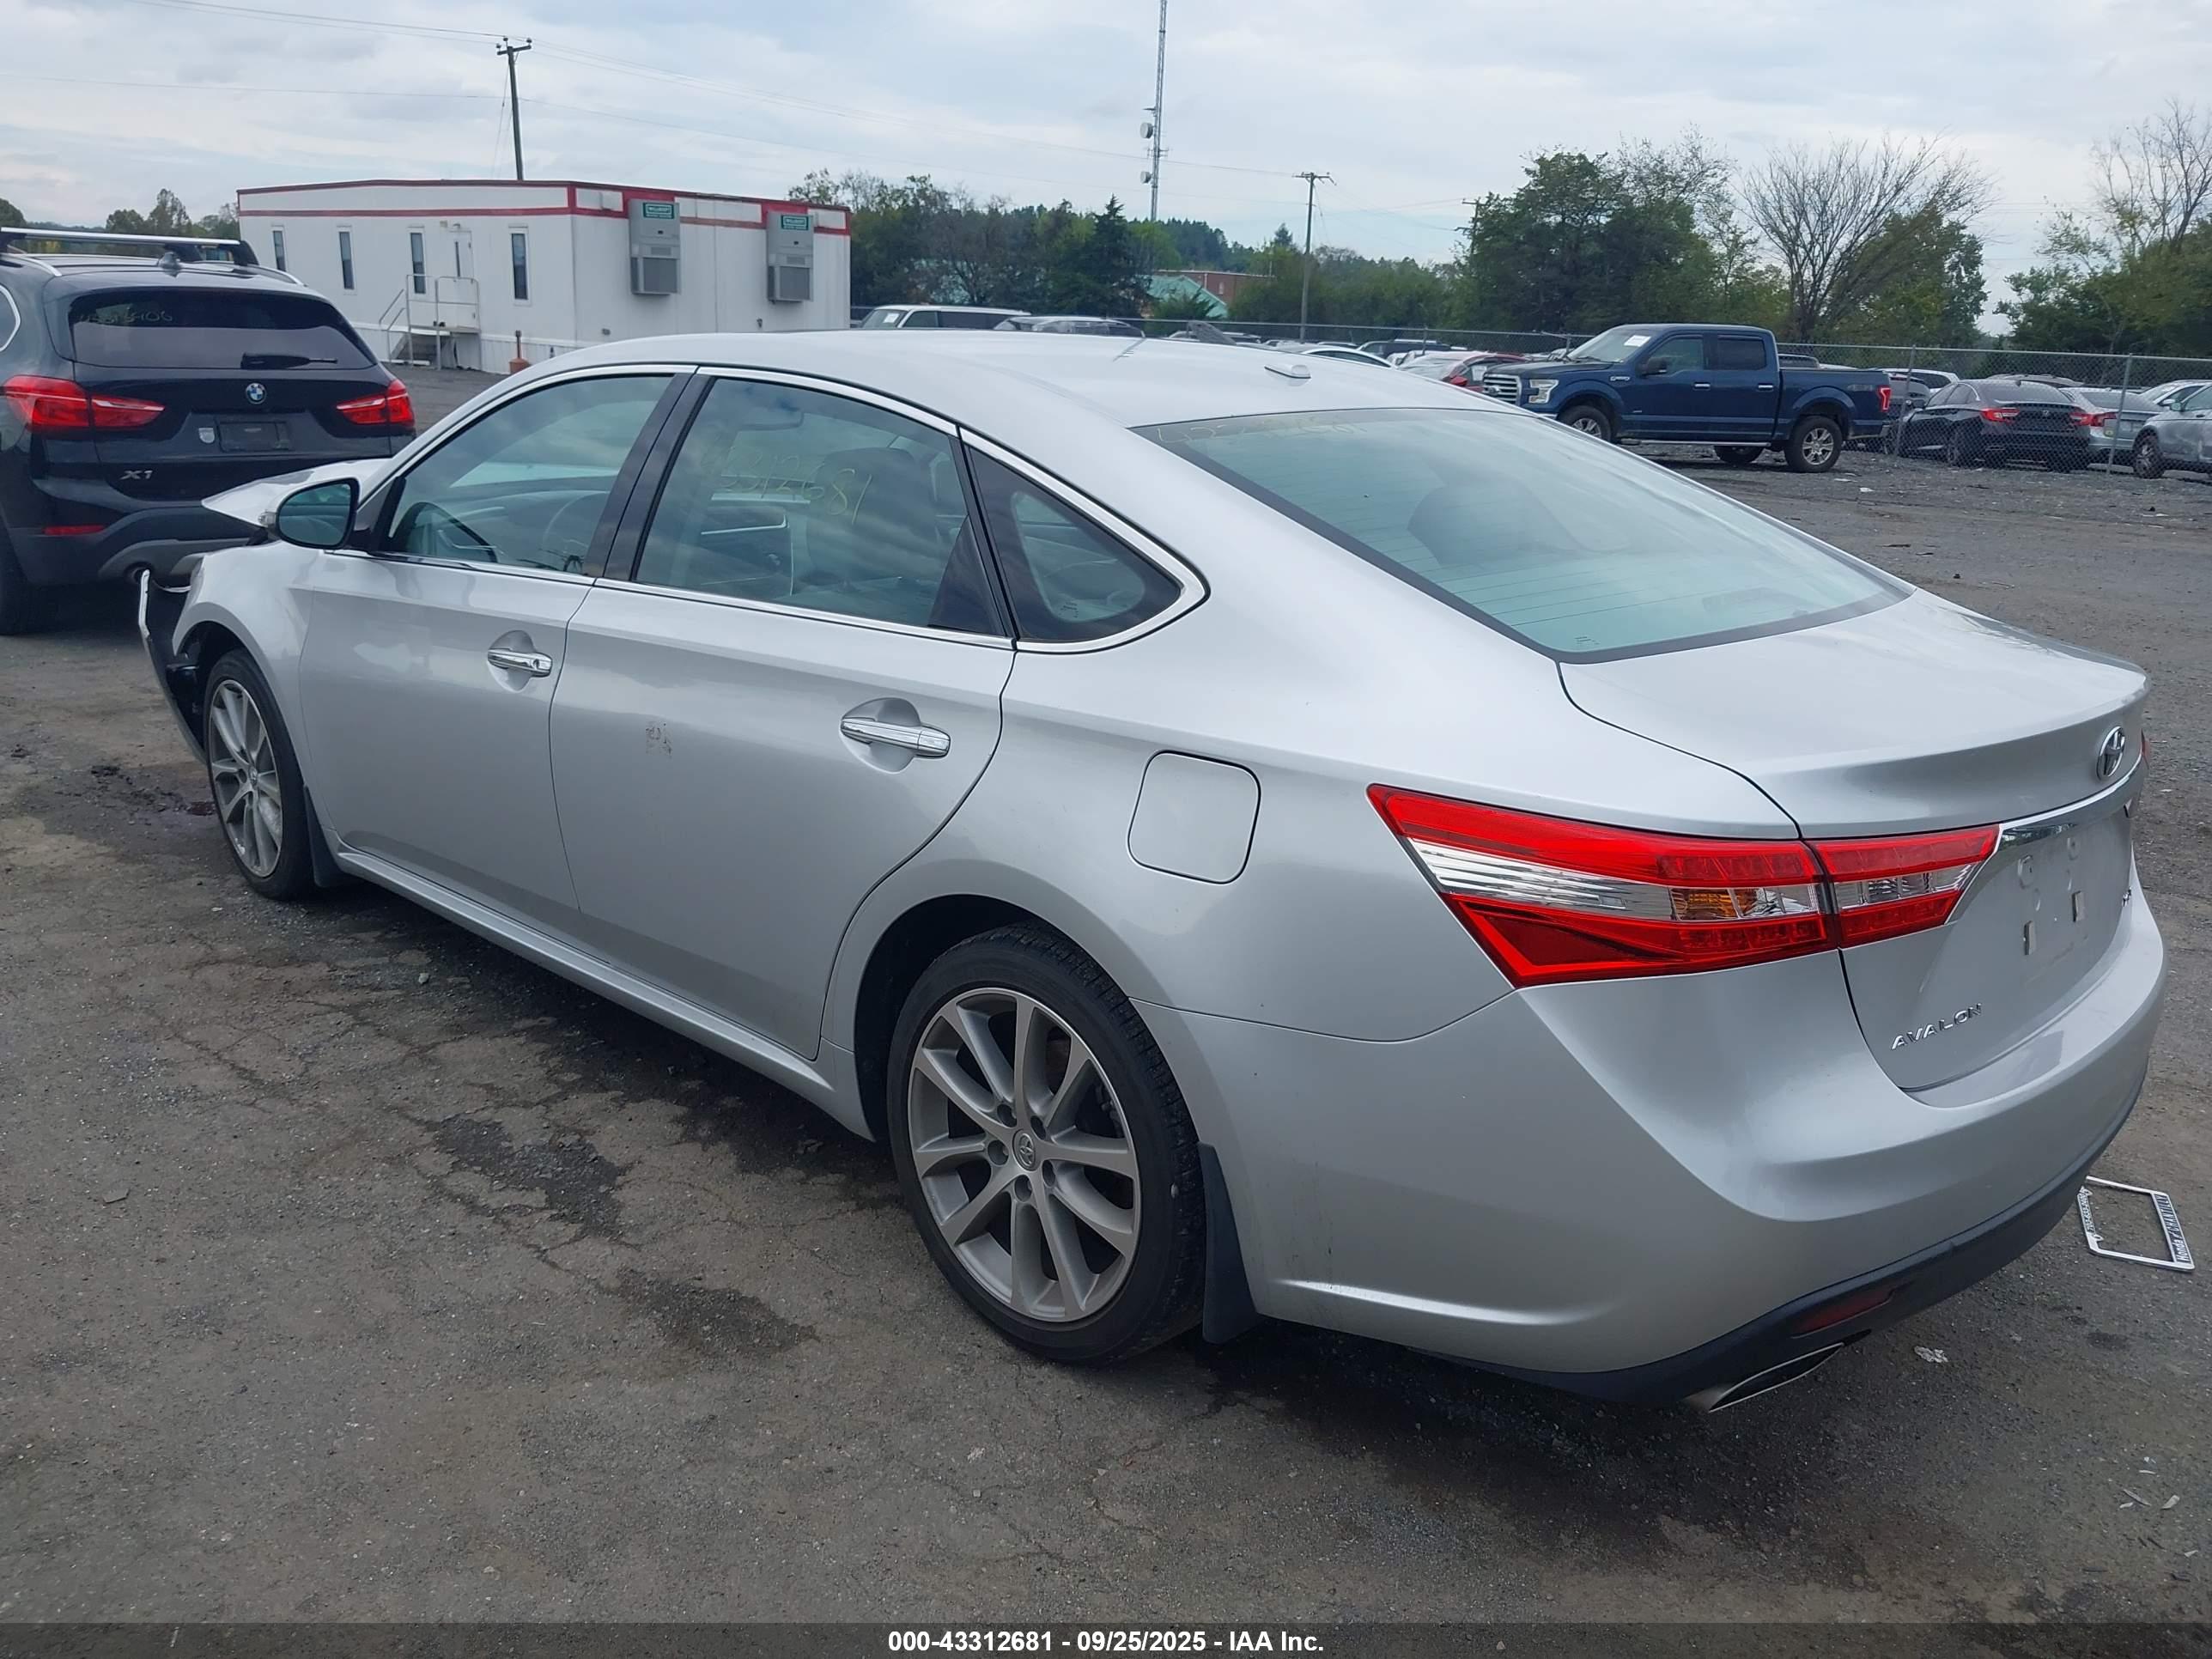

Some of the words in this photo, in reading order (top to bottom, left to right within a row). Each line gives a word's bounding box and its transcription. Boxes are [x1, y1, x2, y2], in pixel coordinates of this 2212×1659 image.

[119, 470, 153, 480] X1
[1891, 1002, 1983, 1050] AVALON
[2155, 1194, 2180, 1231] CHANTILLY
[2171, 1239, 2191, 1262] Honda
